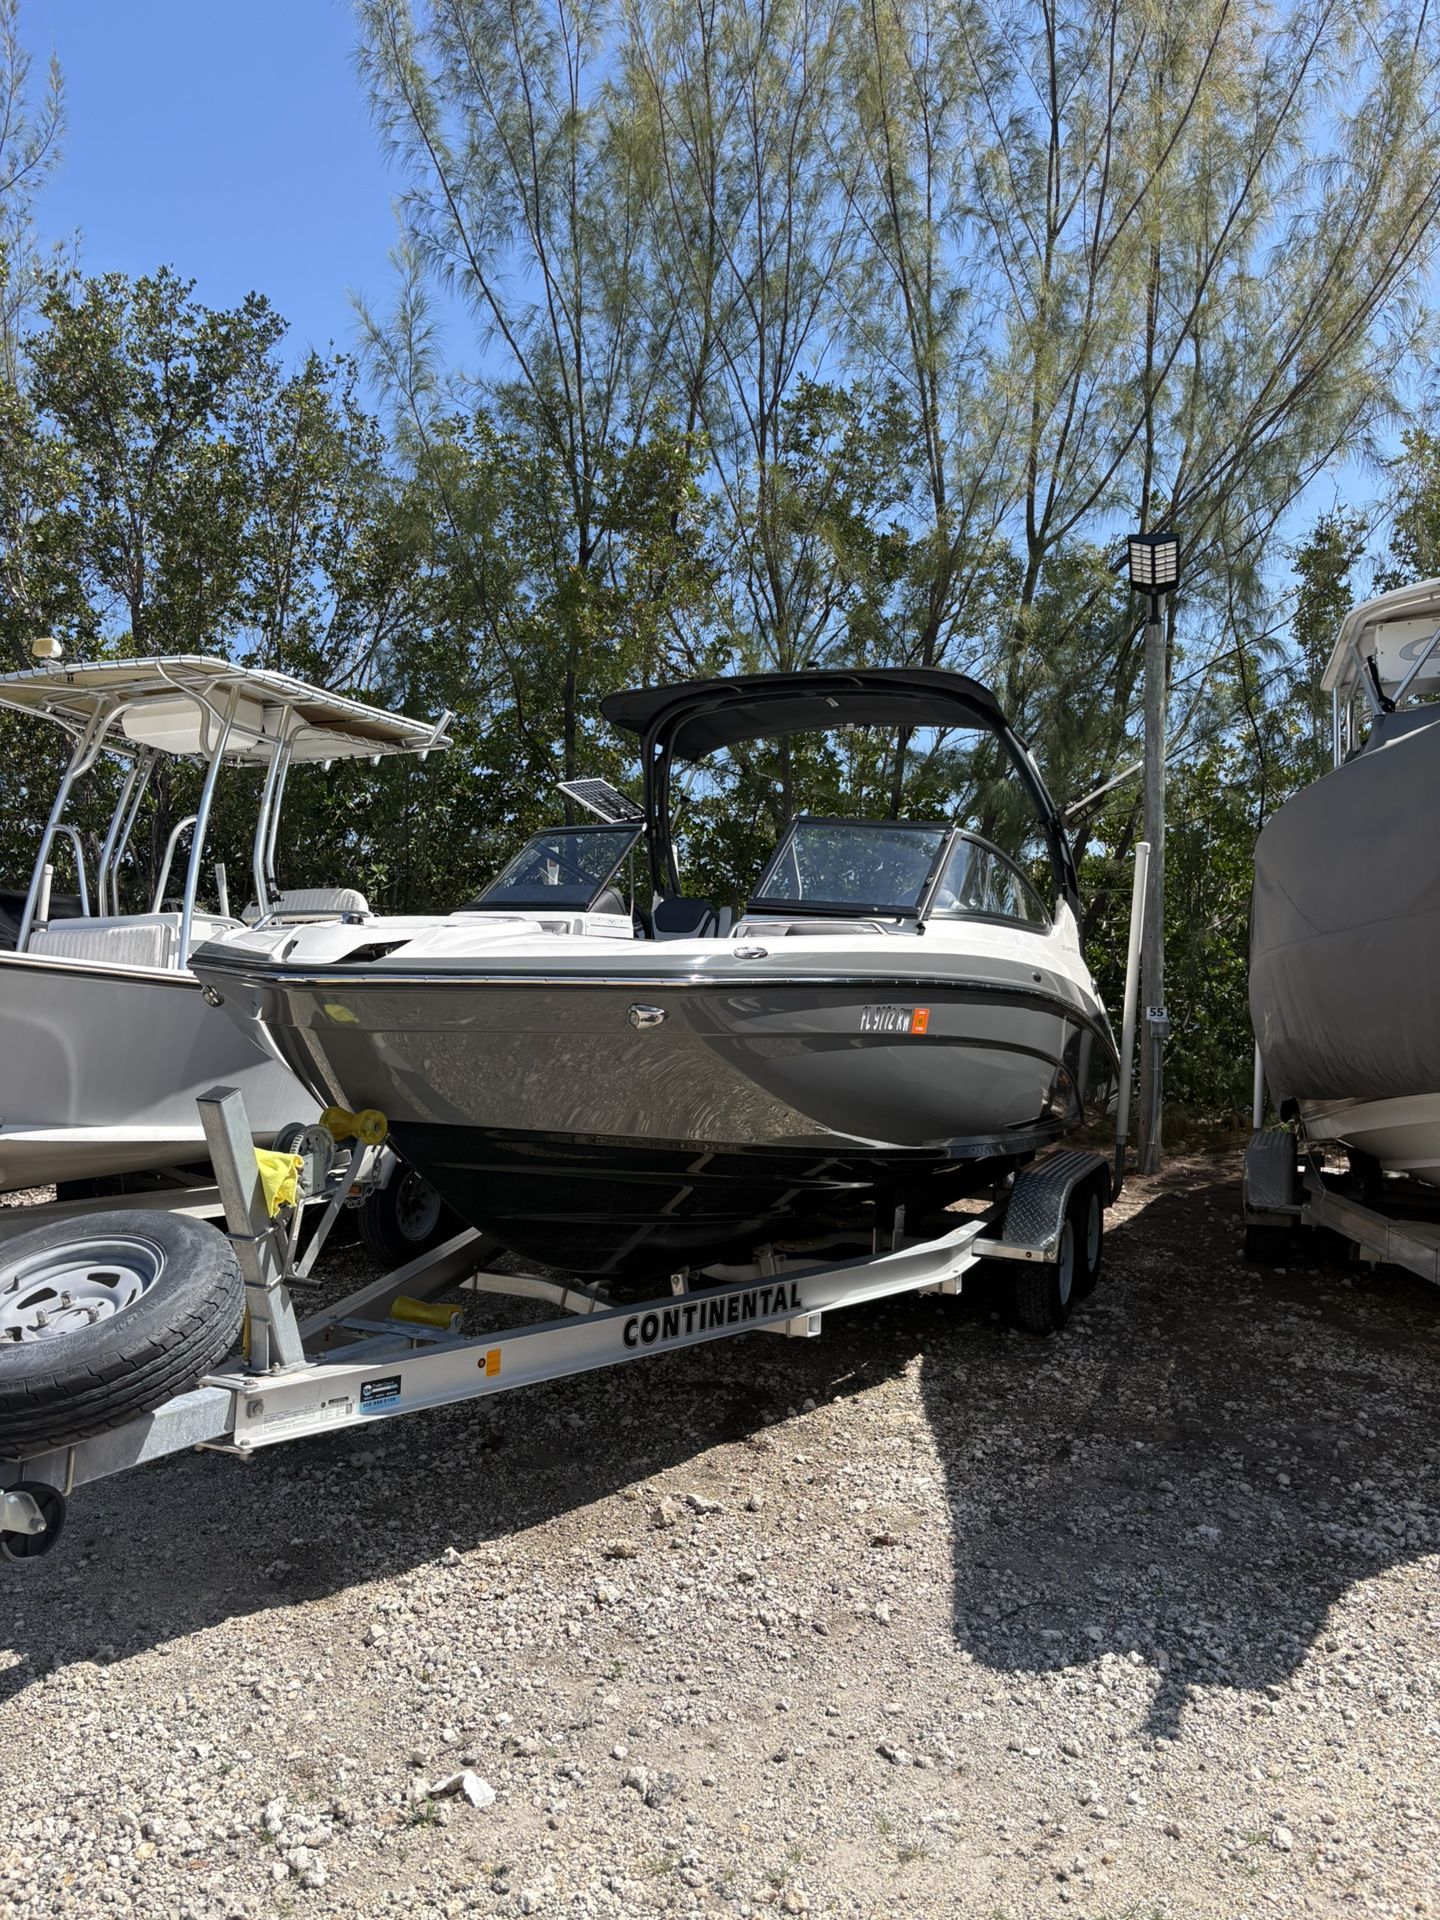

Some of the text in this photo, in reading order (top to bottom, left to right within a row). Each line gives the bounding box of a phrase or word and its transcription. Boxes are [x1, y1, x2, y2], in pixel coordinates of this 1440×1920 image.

[860, 1005, 871, 1030] FL
[1149, 1007, 1164, 1017] 55
[623, 1280, 802, 1349] CONTINENTAL
